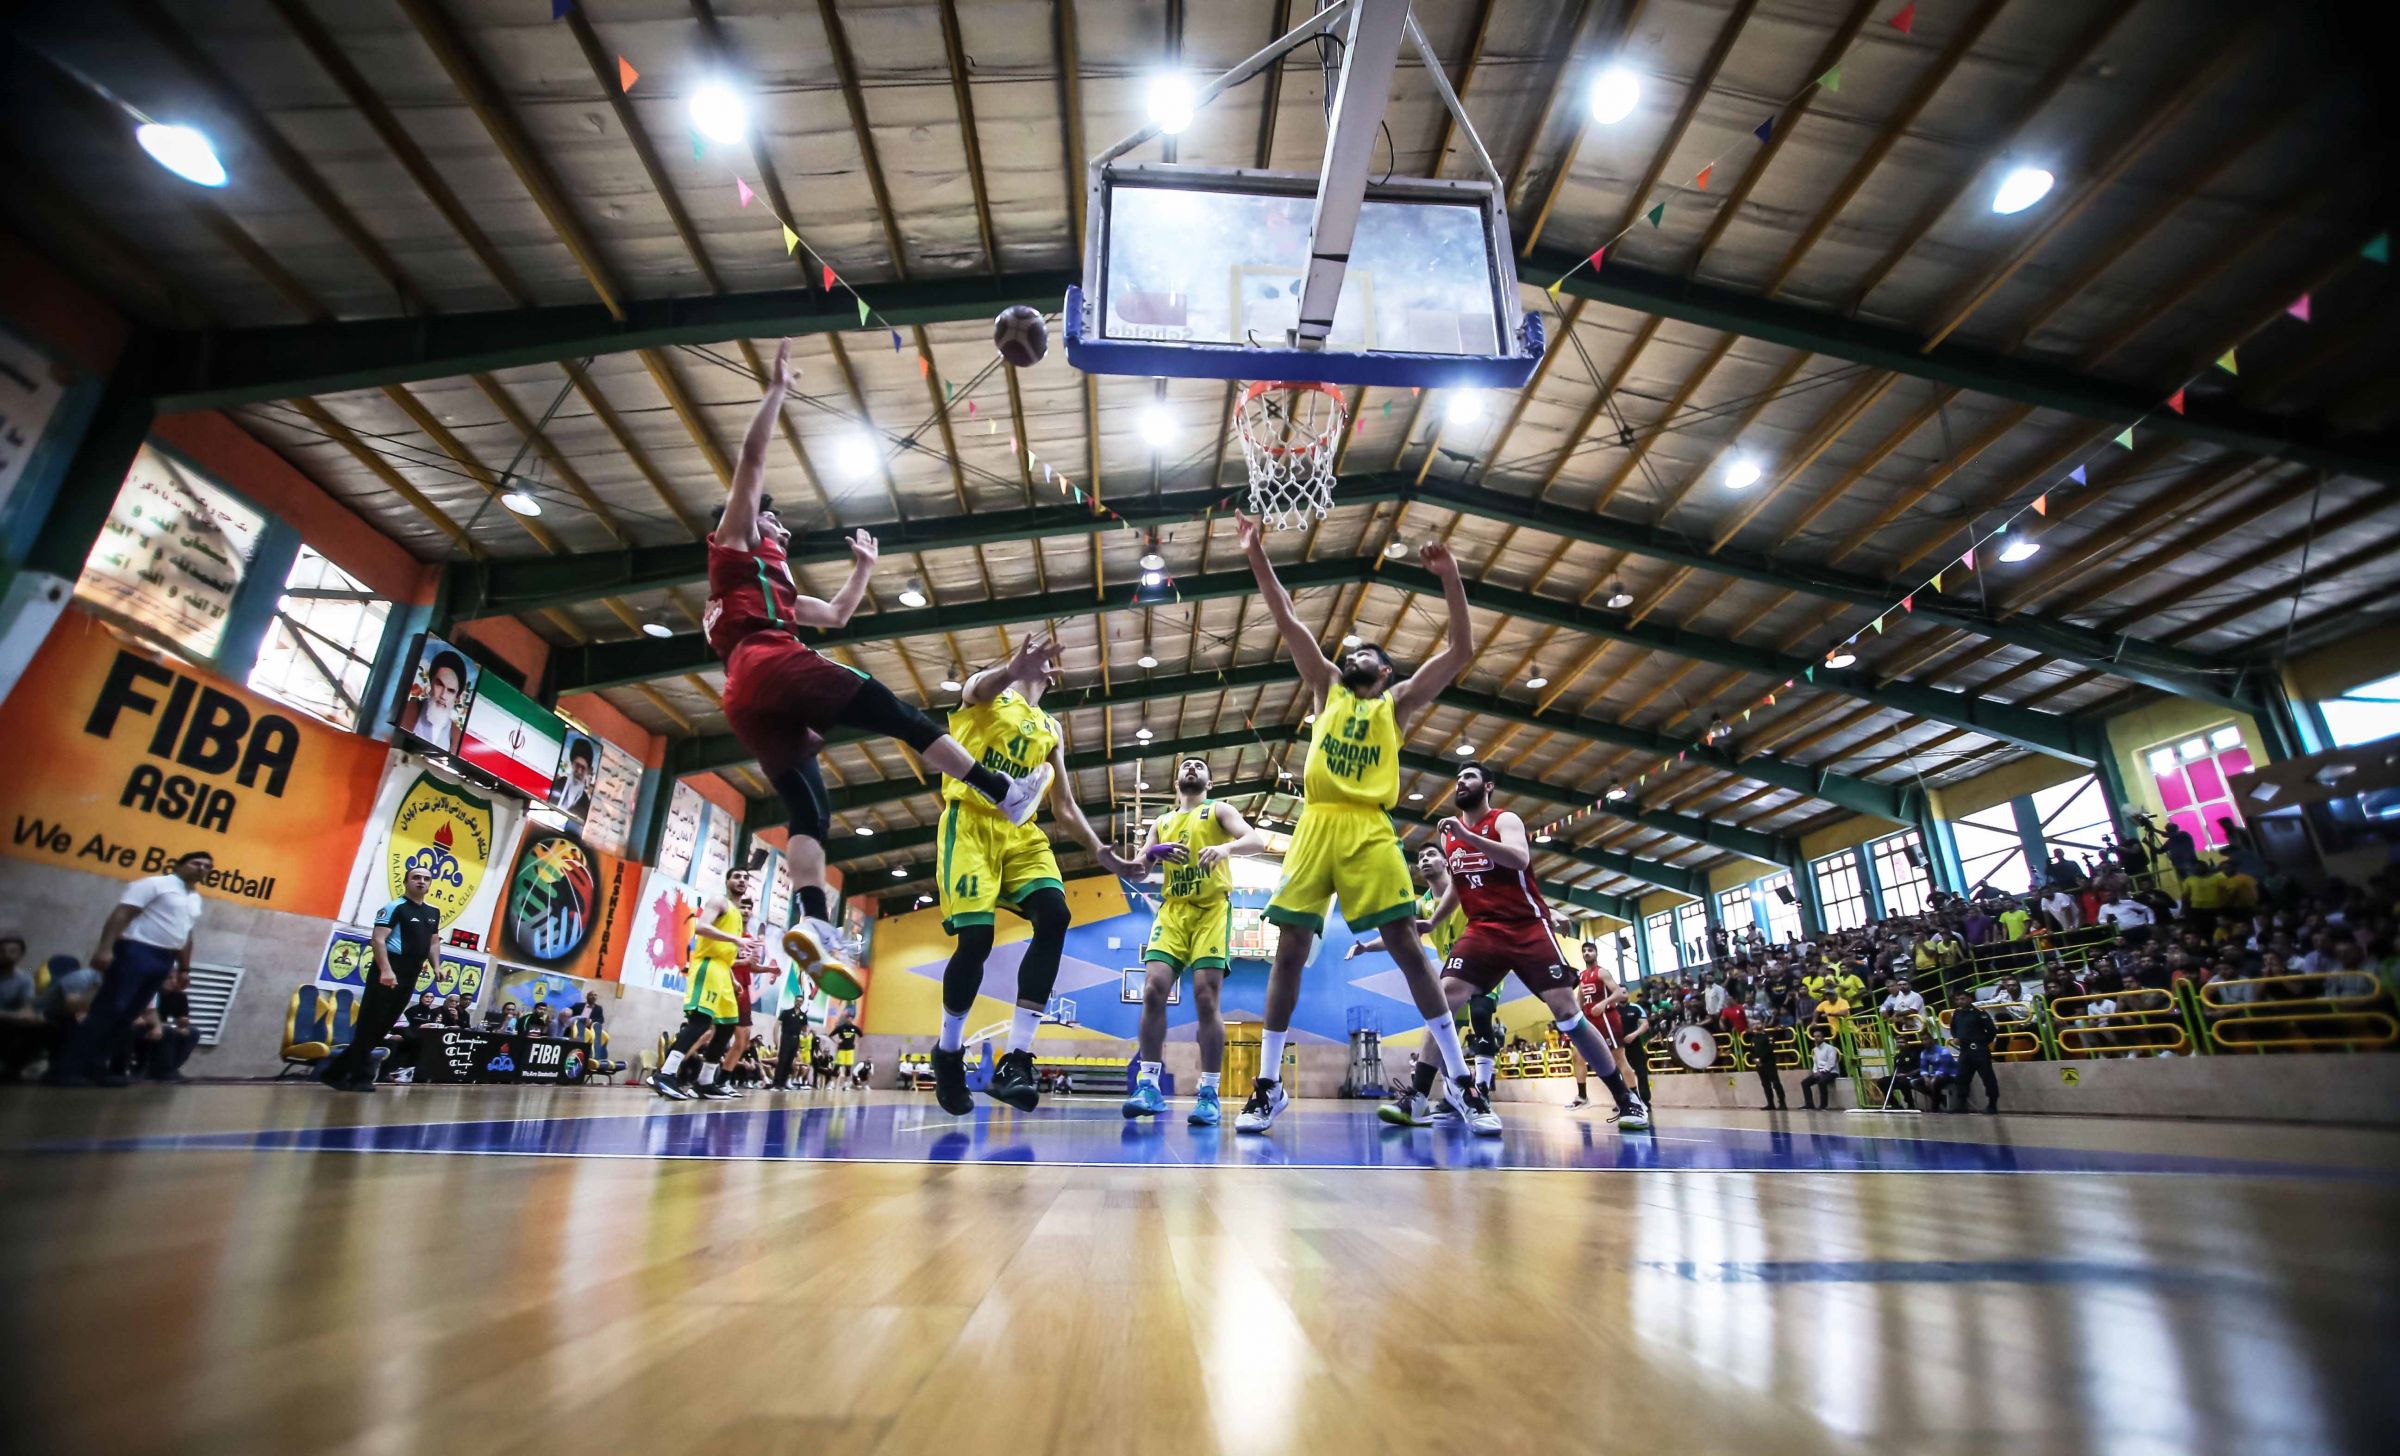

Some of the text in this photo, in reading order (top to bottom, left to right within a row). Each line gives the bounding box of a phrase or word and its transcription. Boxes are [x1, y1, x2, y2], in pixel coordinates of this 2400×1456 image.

[83, 648, 300, 799] FIBA
[1343, 716, 1370, 741] 23
[1007, 735, 1031, 762] 41
[1319, 732, 1381, 768] ABADAN
[1326, 756, 1367, 782] NAFT
[118, 763, 237, 835] ASIA
[12, 814, 277, 901] We Are Baetball
[393, 853, 404, 896] PALAYES
[955, 873, 979, 898] 41
[1171, 880, 1202, 897] NAFT
[595, 861, 624, 978] BASKETBALL
[1151, 925, 1163, 943] 3
[706, 989, 718, 1004] 17
[528, 1043, 561, 1065] FIBA
